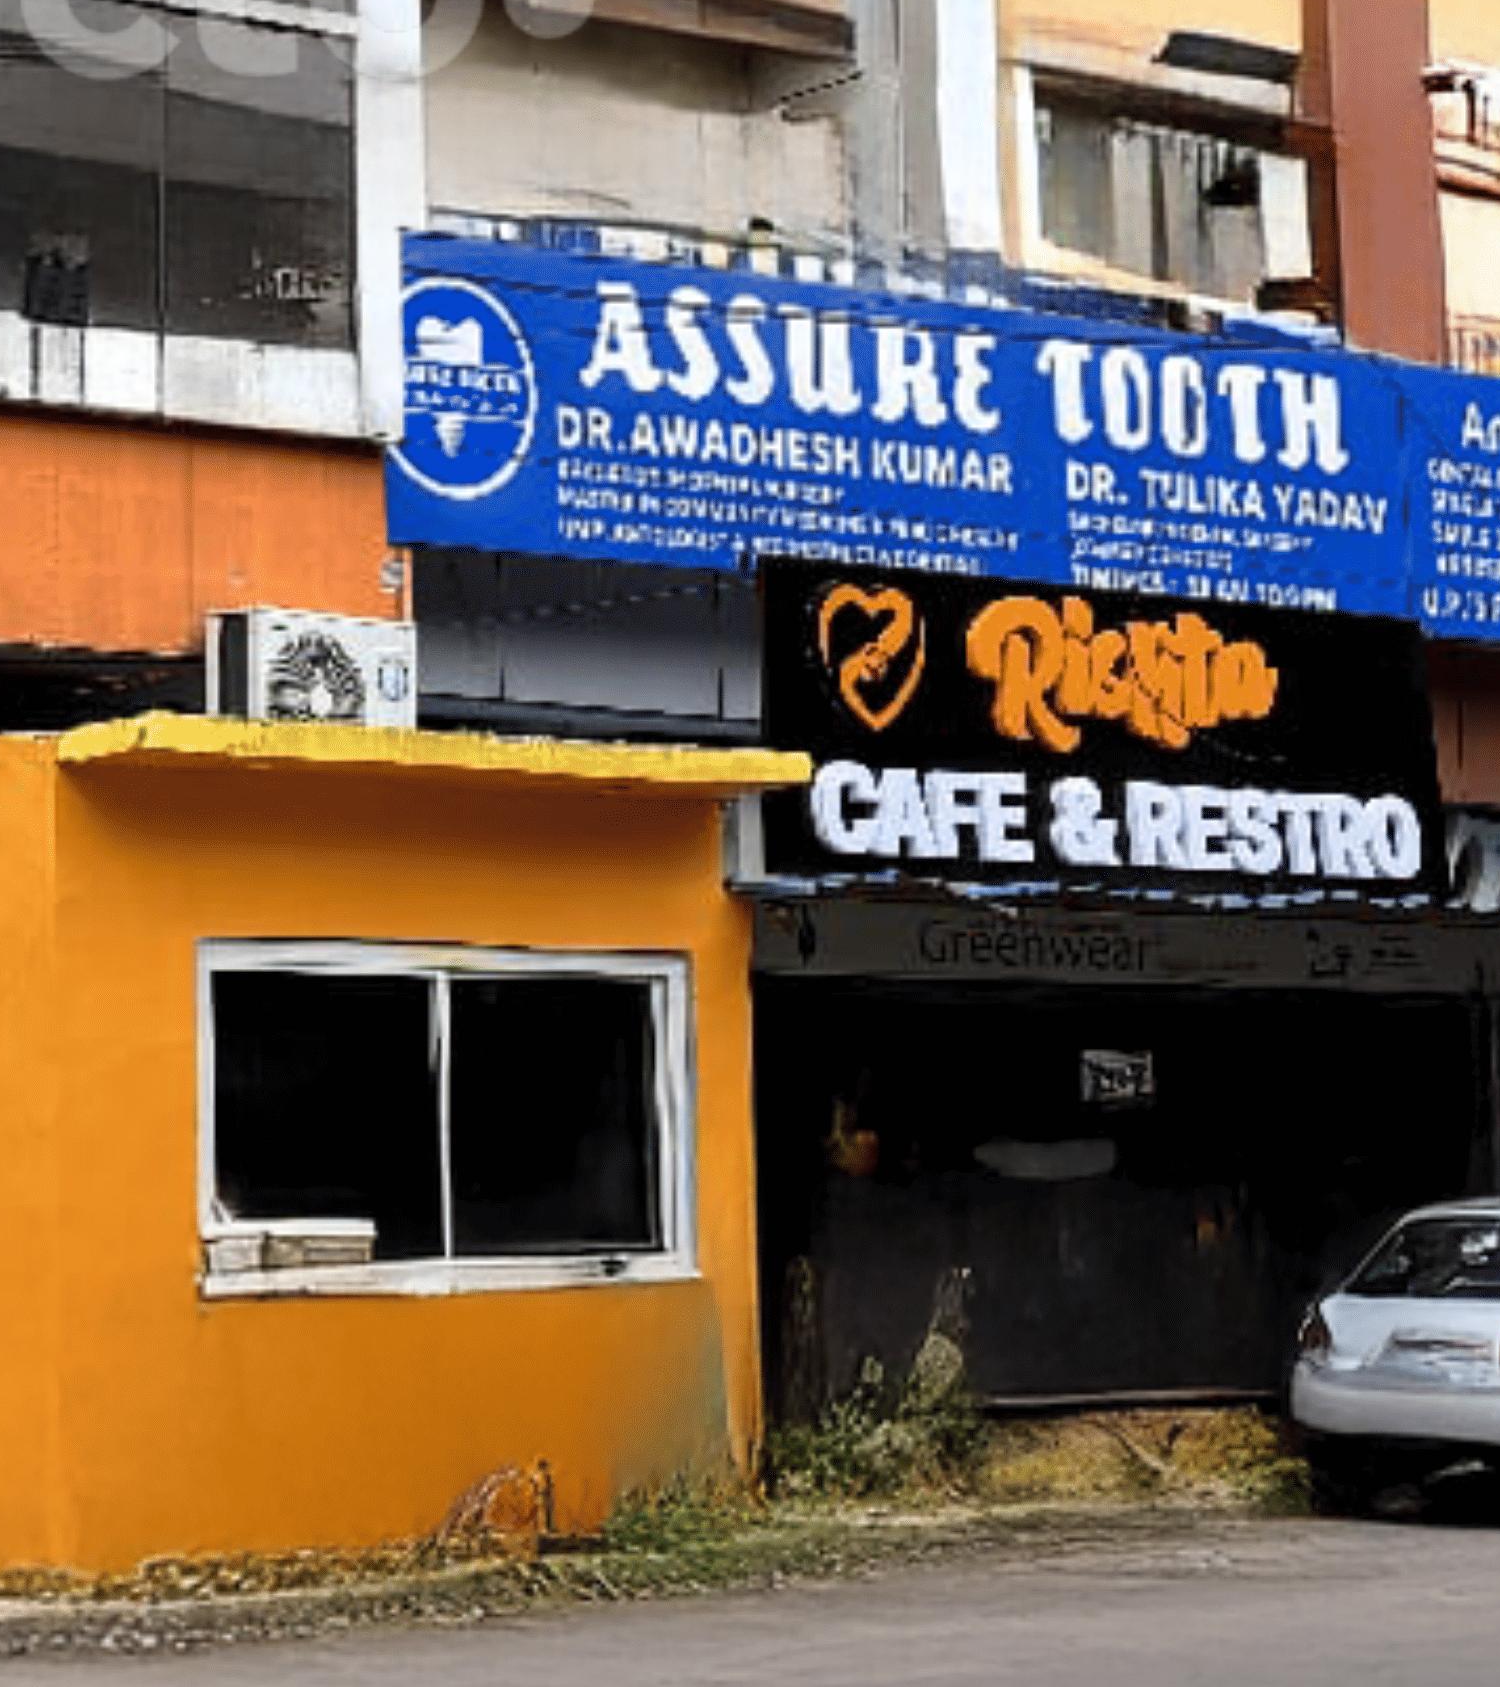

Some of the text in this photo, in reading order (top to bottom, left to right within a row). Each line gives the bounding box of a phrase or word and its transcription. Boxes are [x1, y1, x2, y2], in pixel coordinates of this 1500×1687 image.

[580, 282, 1348, 475] ASSURE TOOTH
[872, 439, 1014, 495] KUMAR
[1066, 460, 1128, 505] DR.
[1139, 467, 1267, 522] TULIKA
[1273, 483, 1388, 535] YADAV
[810, 760, 1422, 881] CAFE & RESTRO
[918, 918, 1154, 974] Greenwear
